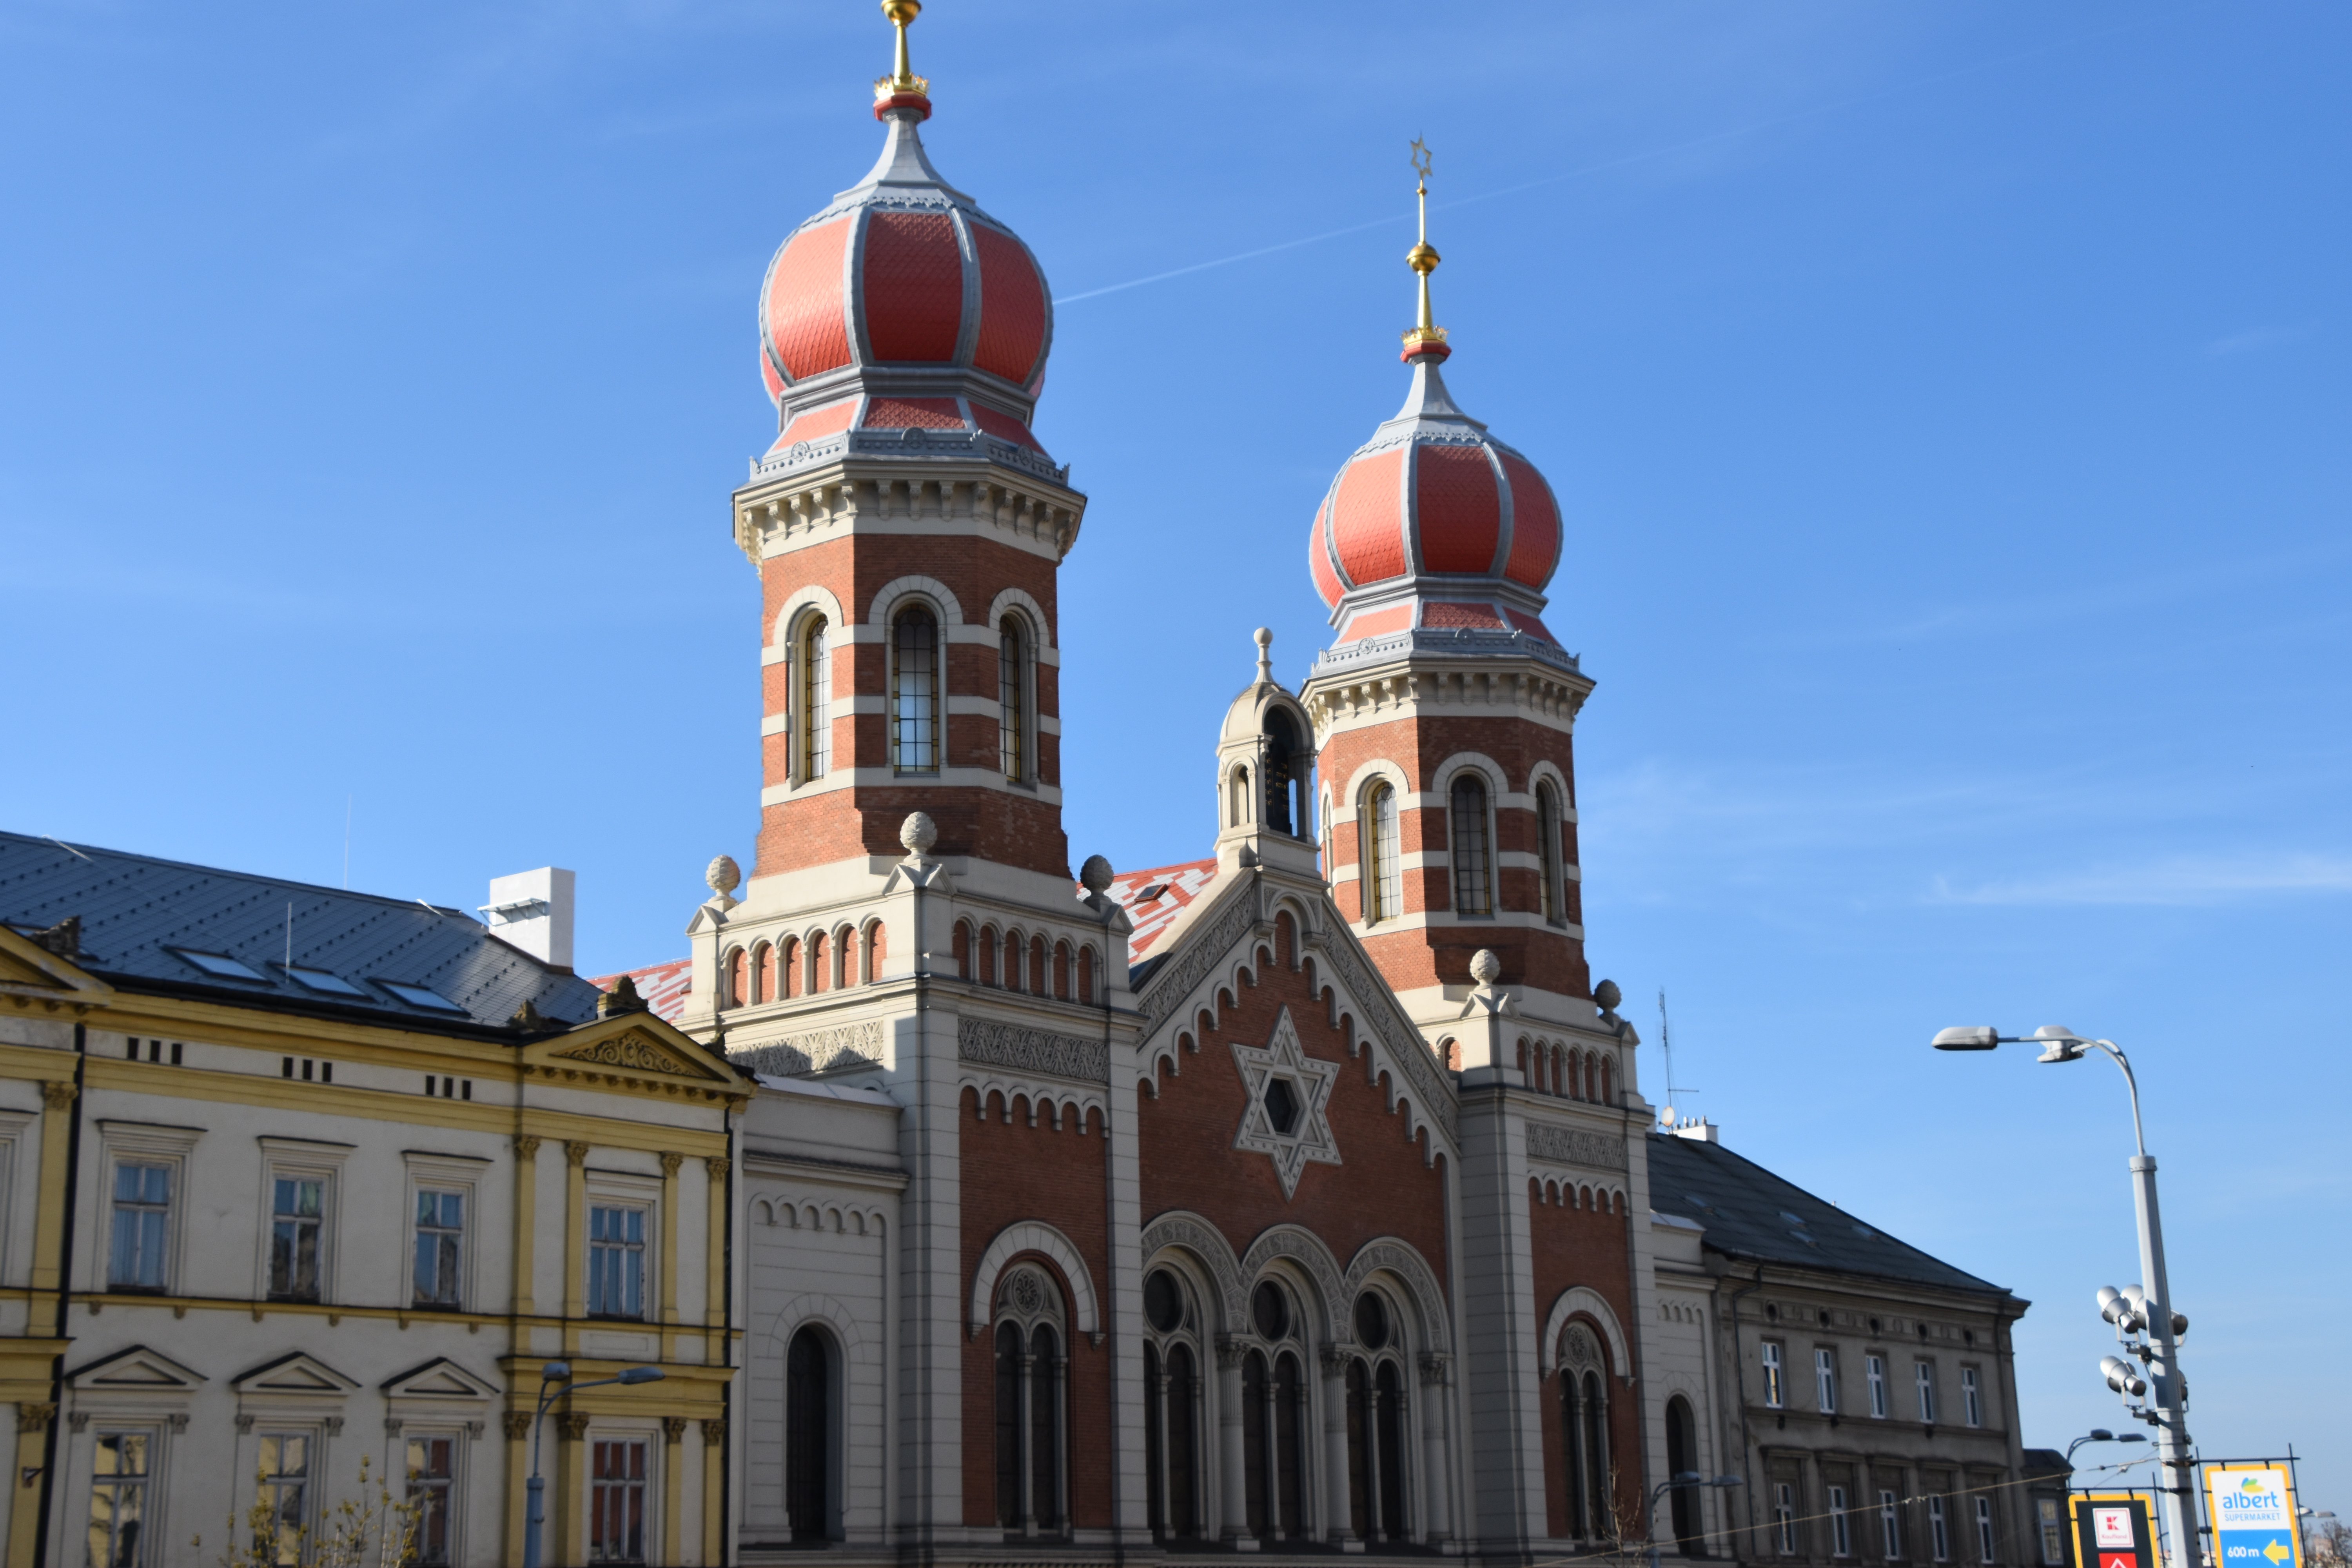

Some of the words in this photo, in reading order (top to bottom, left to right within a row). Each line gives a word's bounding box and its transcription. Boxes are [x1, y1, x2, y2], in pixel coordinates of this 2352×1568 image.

[2223, 1491, 2279, 1508] albert
[2225, 1513, 2280, 1521] SUPERMARKET
[2227, 1546, 2247, 1557] 600
[2248, 1549, 2259, 1557] m
